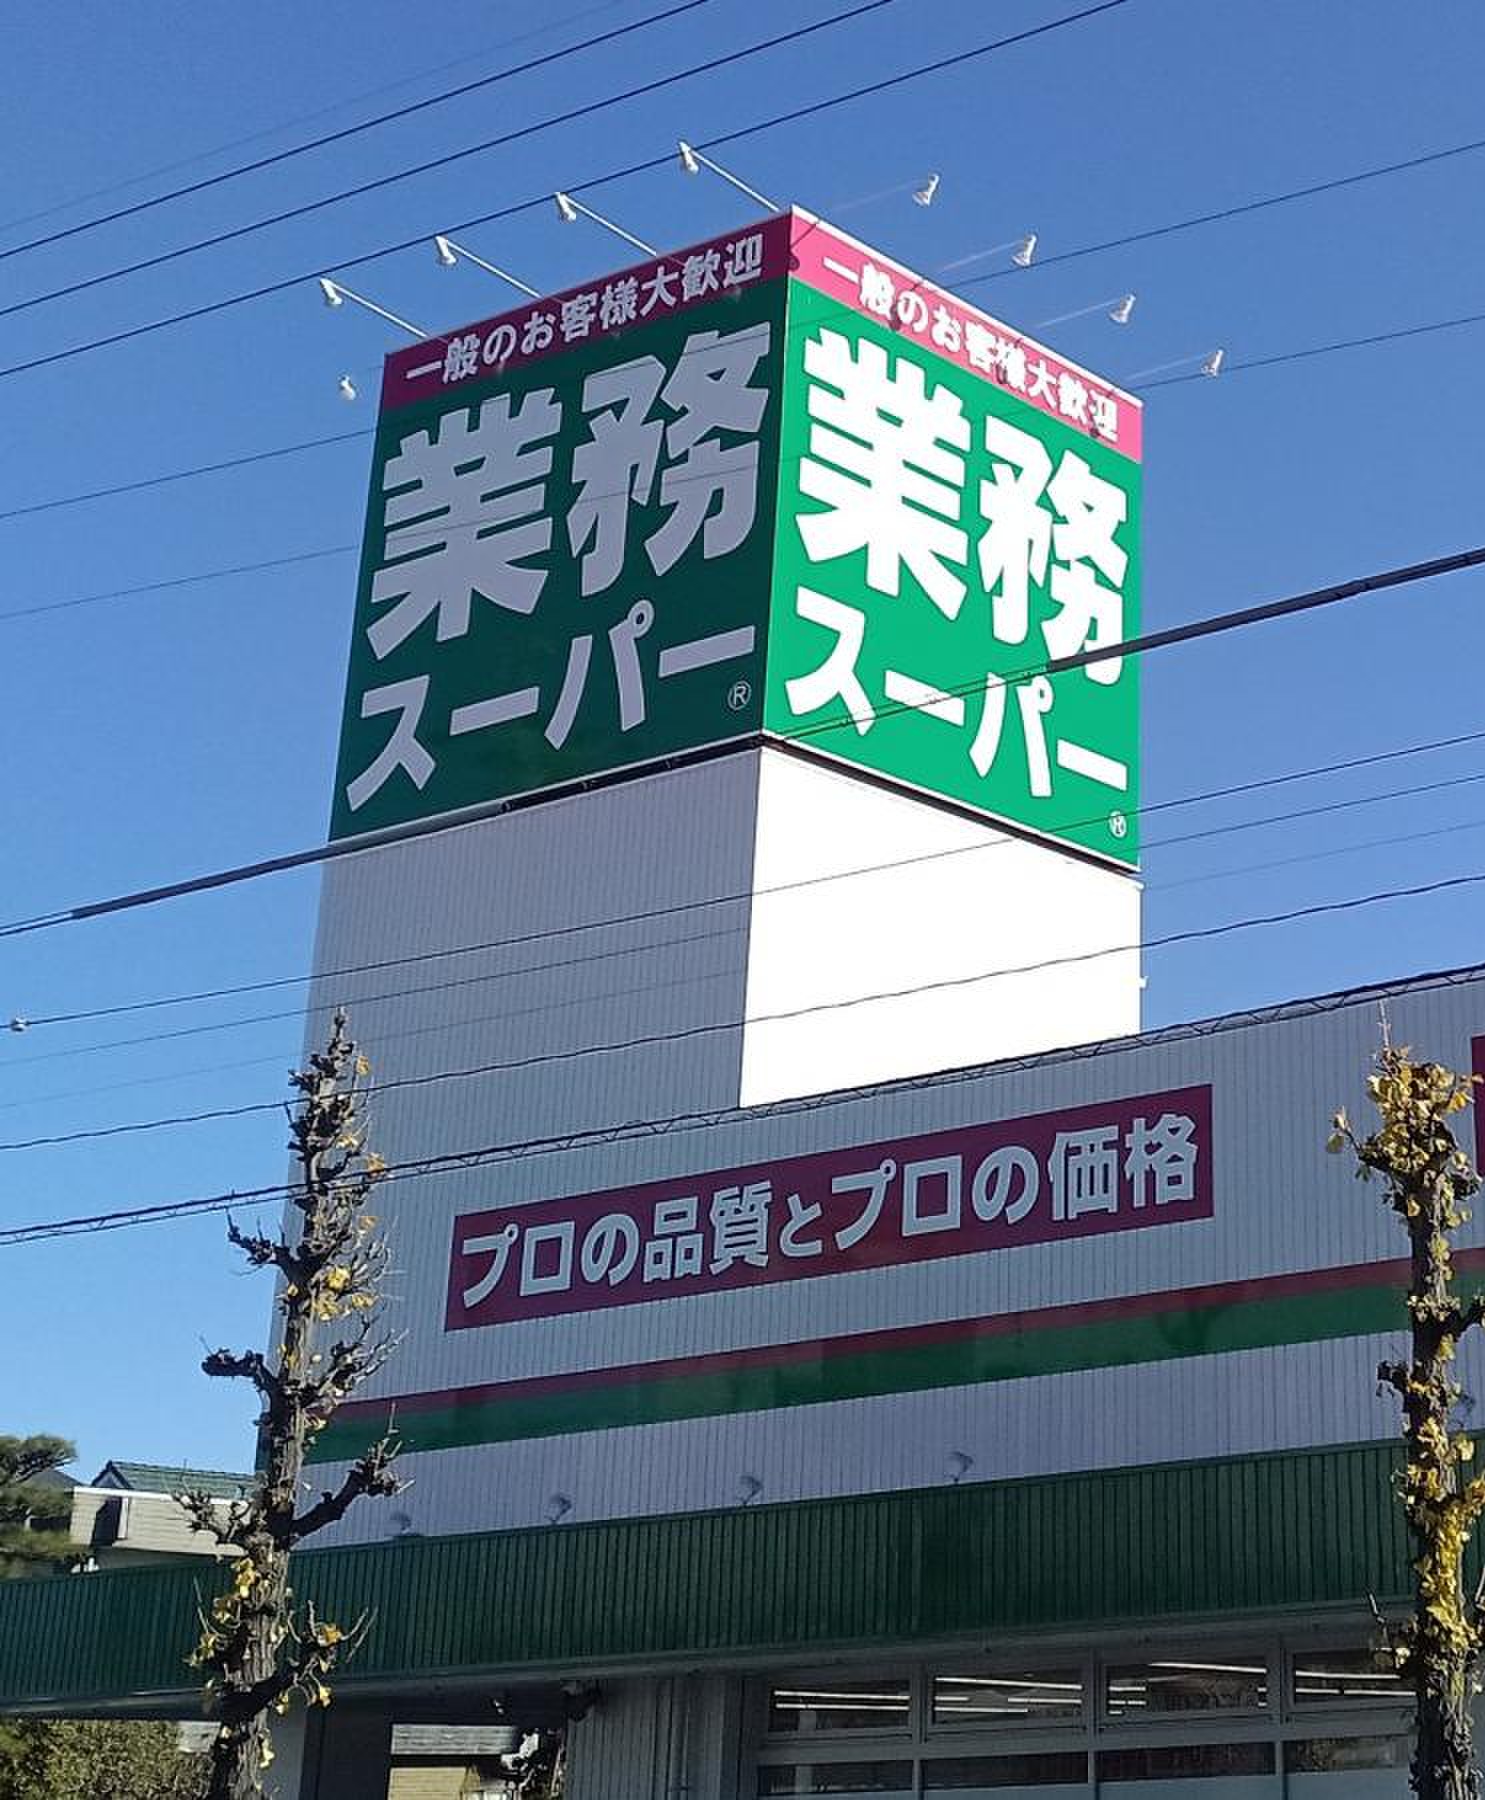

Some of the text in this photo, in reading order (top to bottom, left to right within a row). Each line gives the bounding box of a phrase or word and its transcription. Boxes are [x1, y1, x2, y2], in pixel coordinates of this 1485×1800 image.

[404, 234, 764, 384] 一般のお客様大歓迎
[822, 255, 1120, 444] 一般のお客様大歓迎
[364, 321, 771, 660] 業務
[795, 327, 1128, 685] 業務
[346, 599, 756, 812] スーパー
[785, 587, 1129, 798] スーパー
[462, 1112, 1200, 1308] プロの品質とプロの価格
